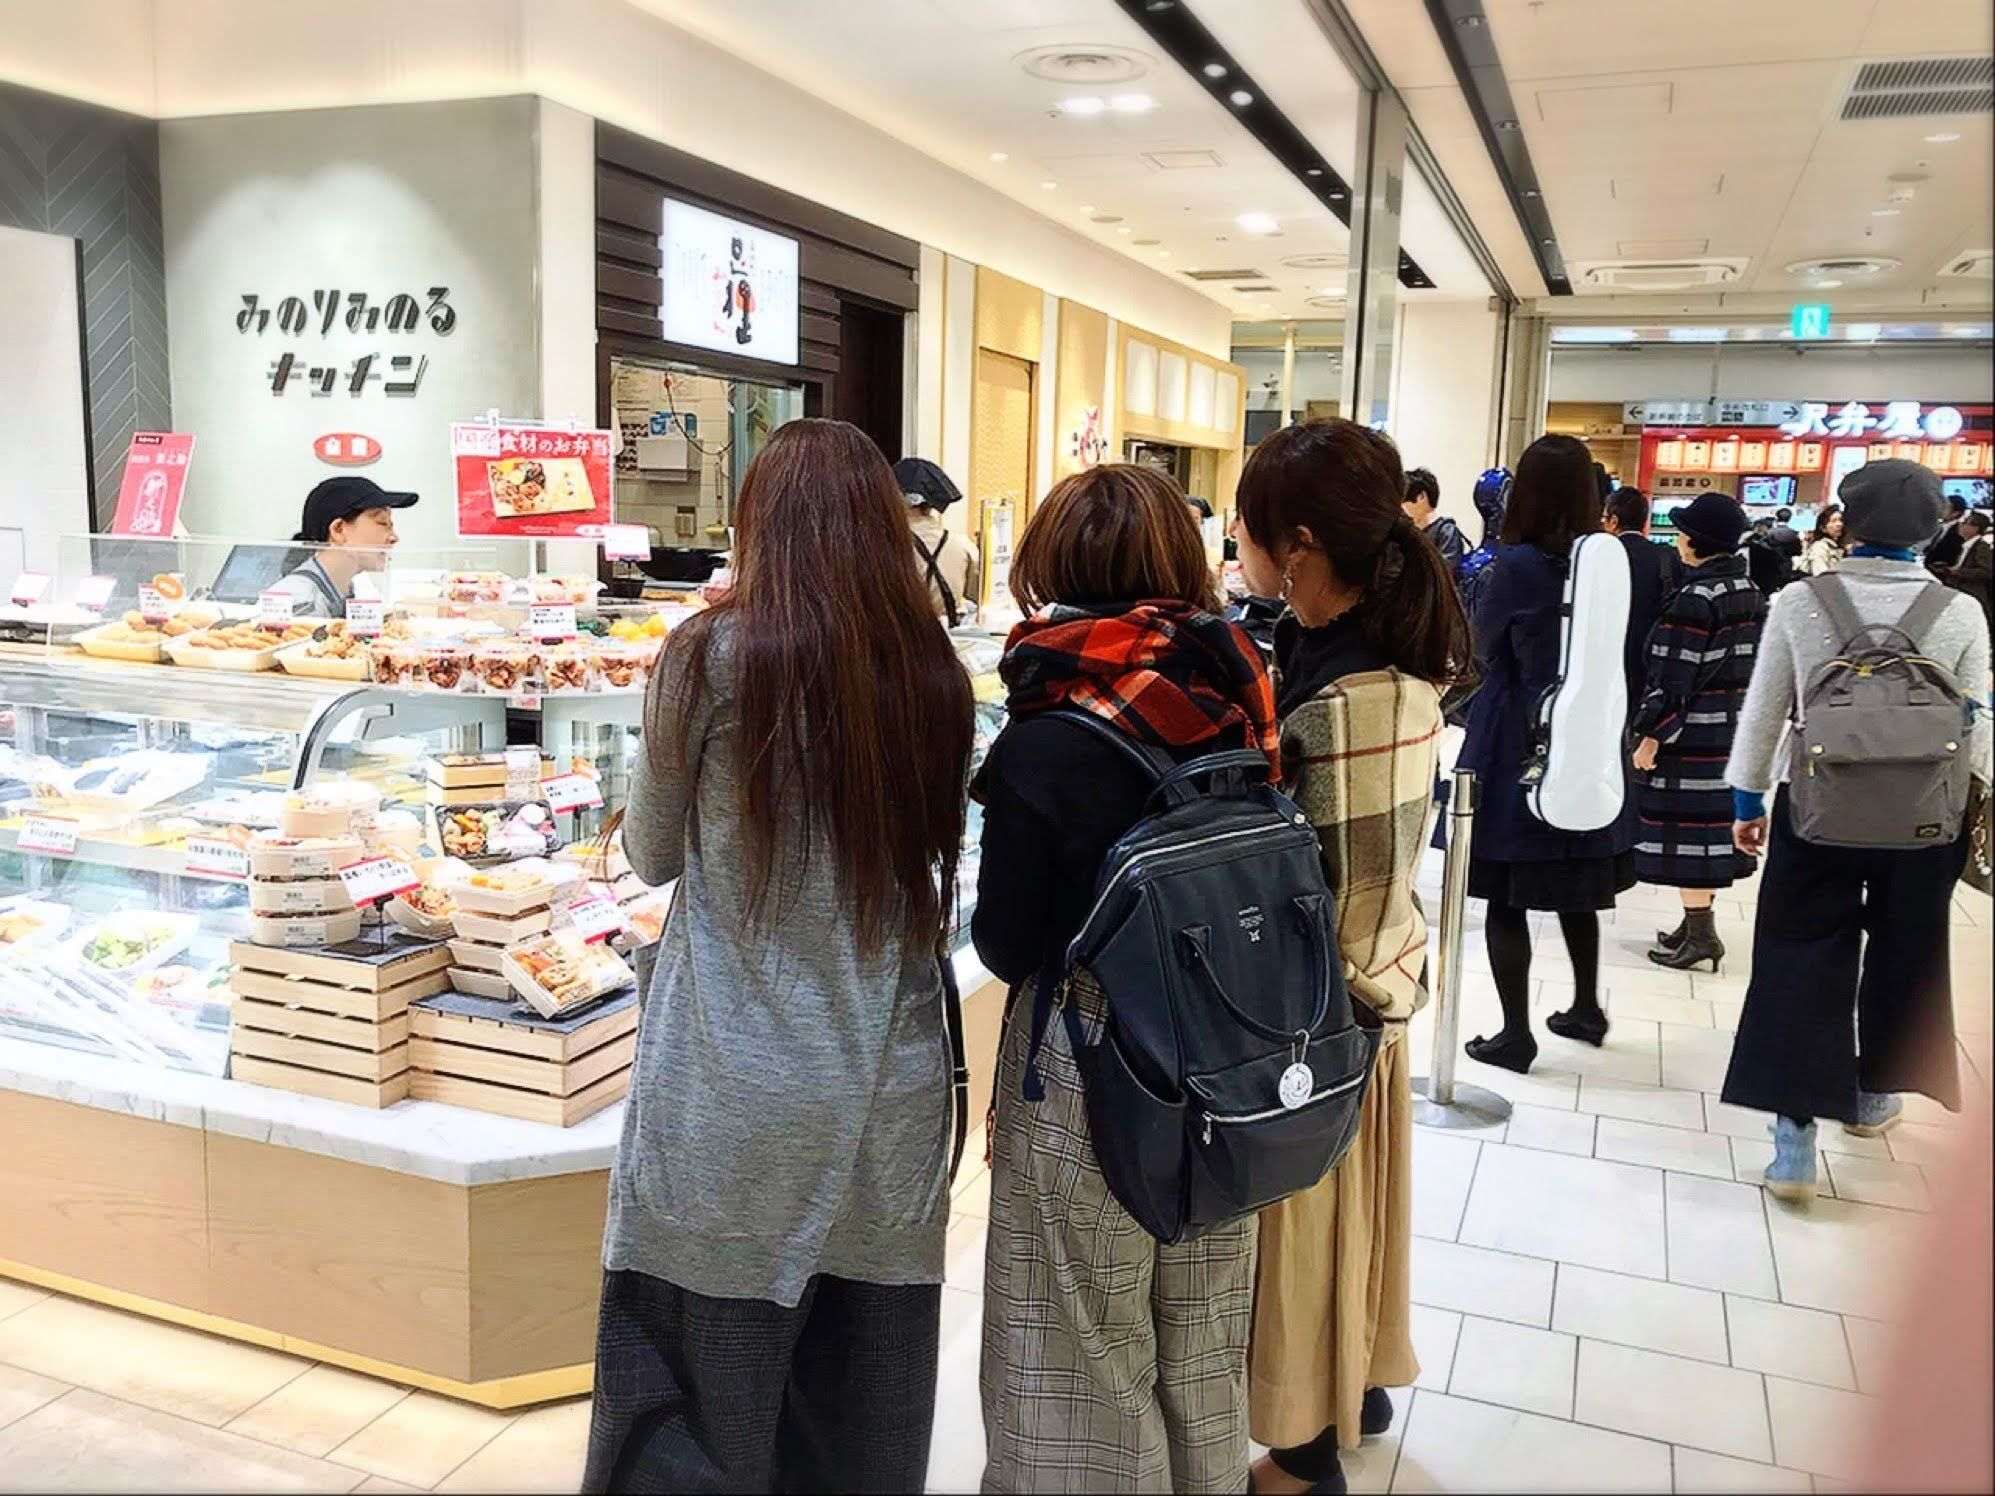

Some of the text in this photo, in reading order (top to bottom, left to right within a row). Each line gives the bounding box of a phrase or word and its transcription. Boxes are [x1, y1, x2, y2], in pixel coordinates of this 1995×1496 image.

[236, 287, 456, 336] みのりみのる
[266, 352, 429, 396] キッチン
